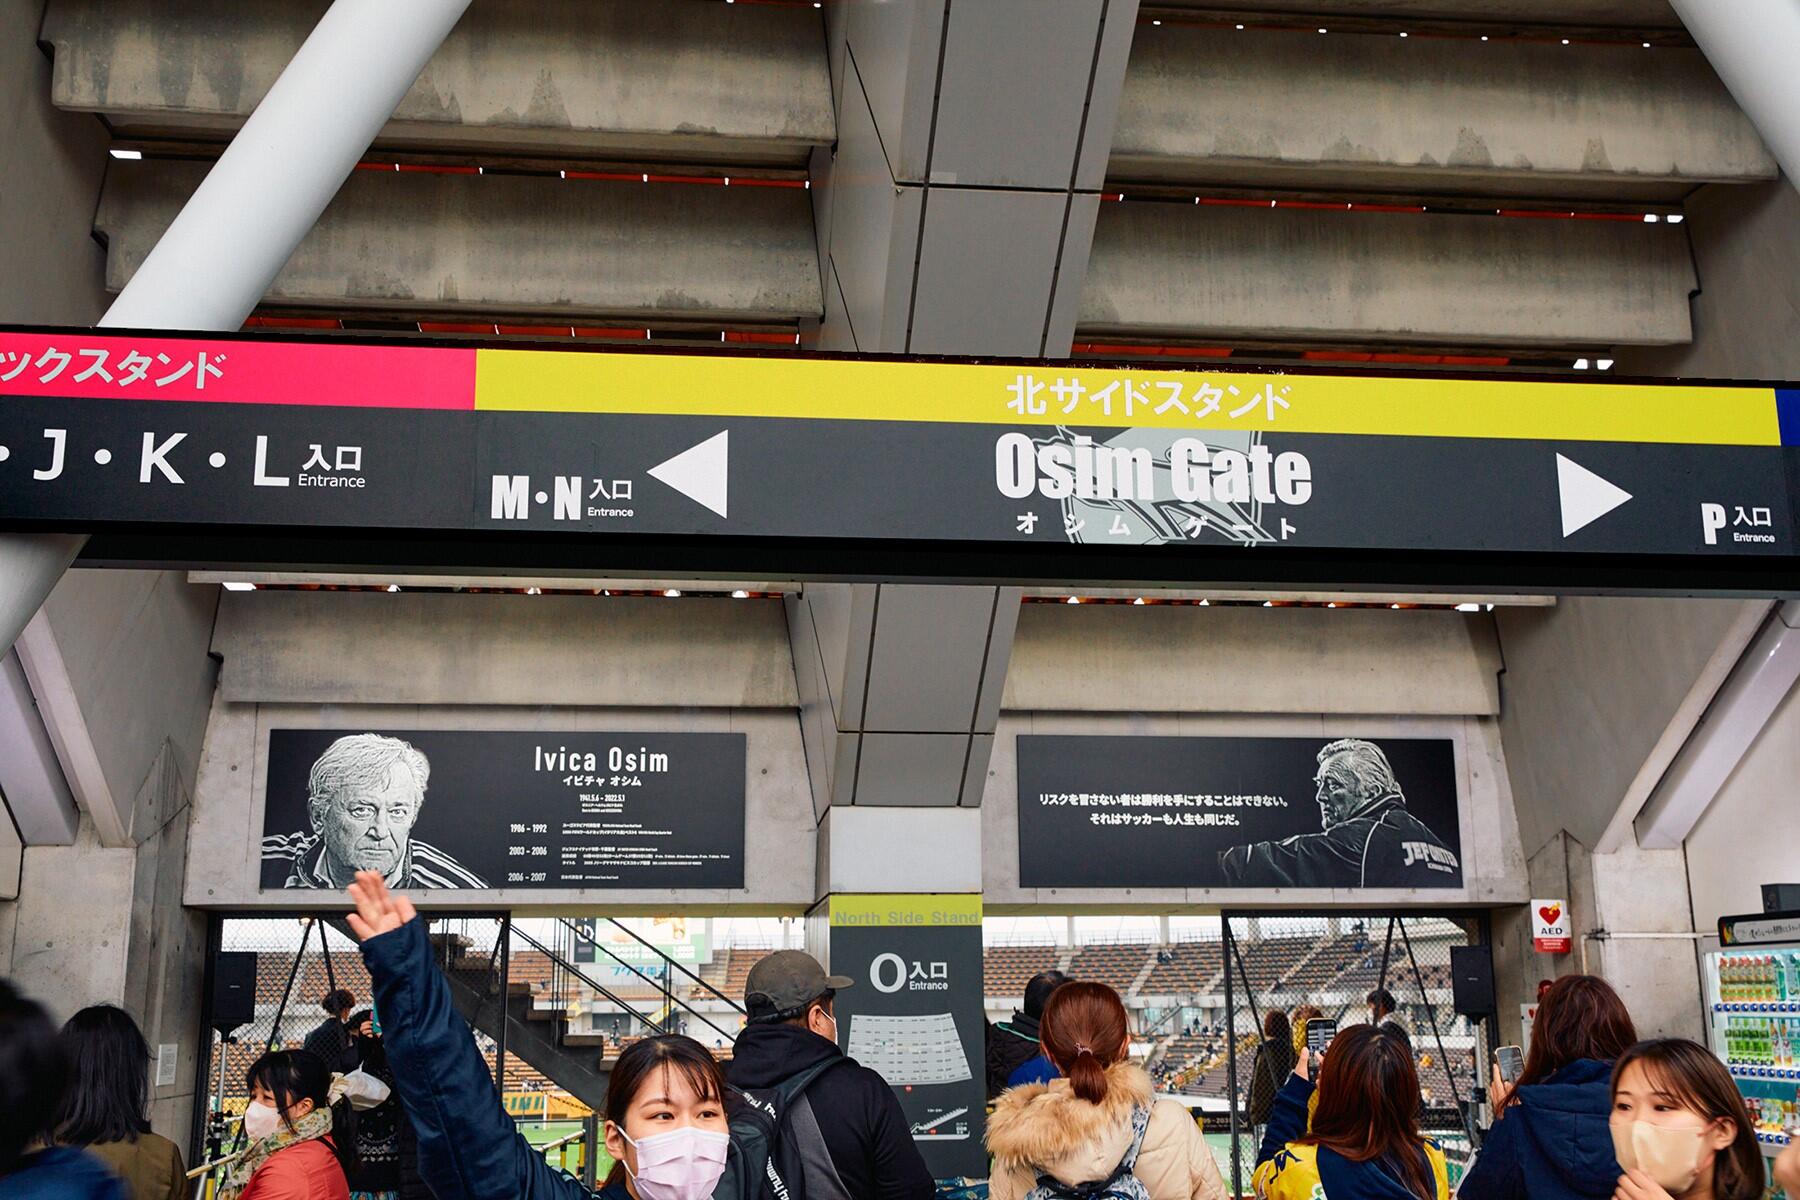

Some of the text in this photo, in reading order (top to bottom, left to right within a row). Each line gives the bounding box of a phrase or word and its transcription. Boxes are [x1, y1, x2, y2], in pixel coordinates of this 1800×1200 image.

[0, 347, 227, 390] ックスタンド
[1006, 374, 1292, 421] 北サイドスタンド
[301, 443, 362, 471] 入口
[996, 432, 1312, 506] Osim Gate
[298, 474, 366, 489] Entrance
[588, 478, 633, 500] 入口
[587, 506, 634, 518] Entrance
[1701, 502, 1772, 545] P 入口
[1733, 532, 1776, 544] Entrance
[534, 746, 669, 773] Ivica Osim
[562, 775, 642, 787] イビチャ オシム
[1089, 812, 1241, 826] それはサッカーも人生も同じだ。
[532, 823, 548, 834] 1992
[508, 846, 525, 856] 2003
[531, 846, 548, 856] 2006
[507, 872, 524, 882] 2006
[530, 872, 547, 882] 2007
[835, 911, 979, 925] North Side Stand
[1541, 927, 1563, 935] AED
[909, 961, 948, 979] 入口
[909, 981, 949, 991] Entrance
